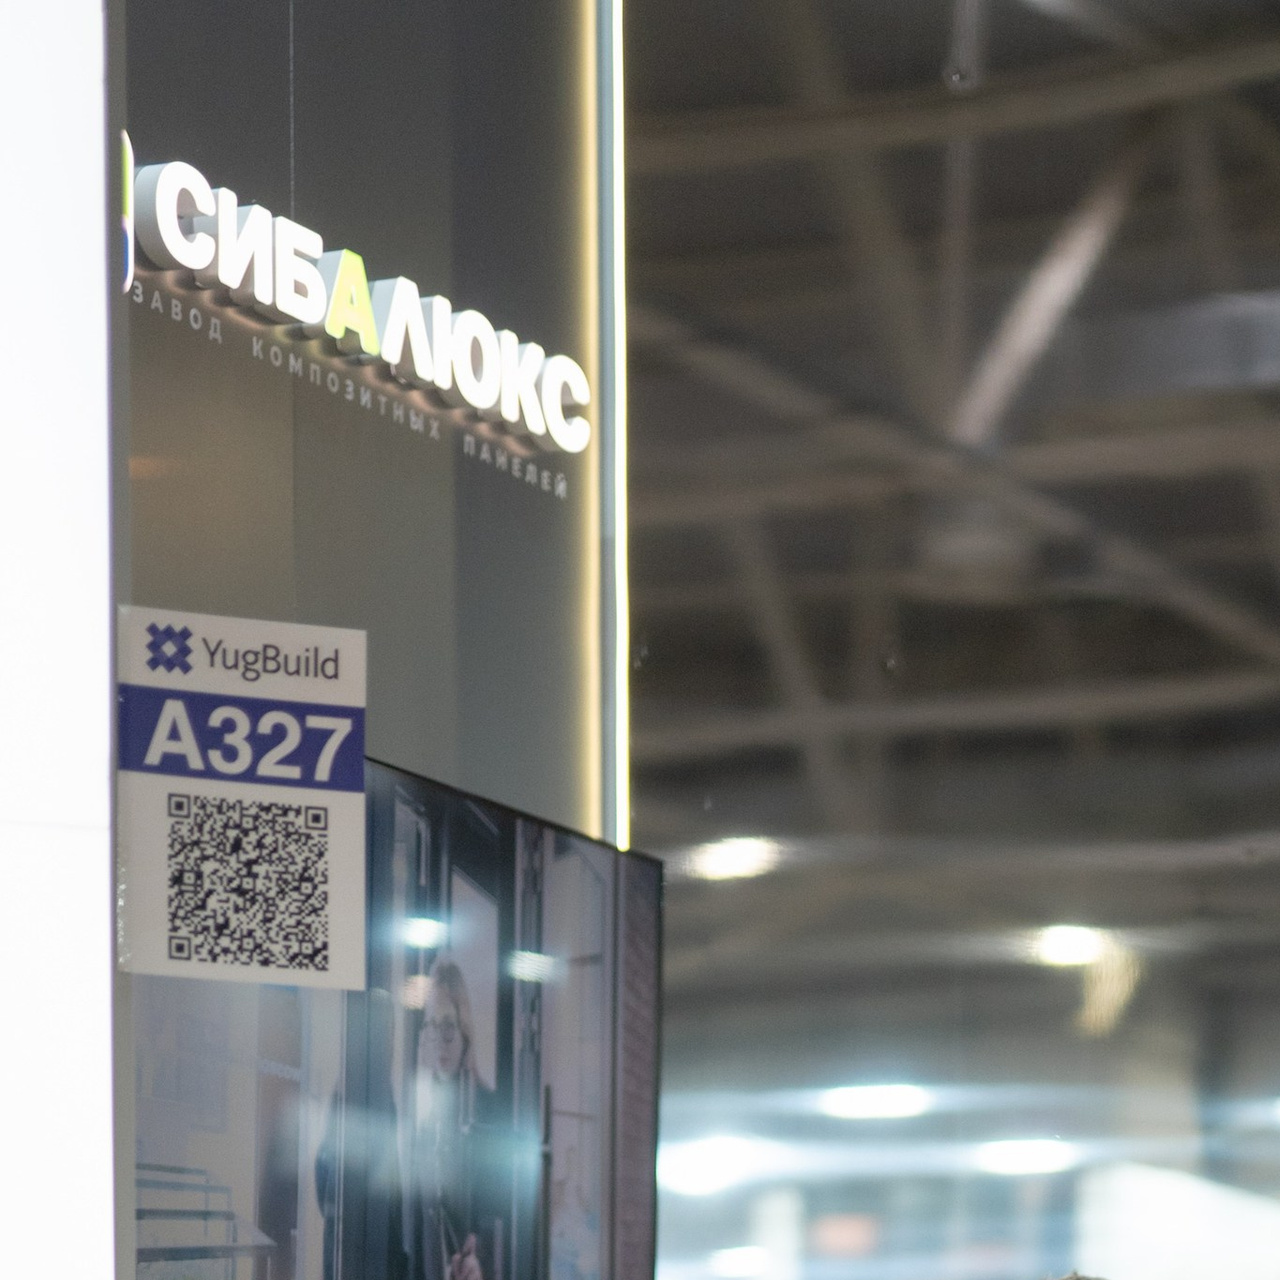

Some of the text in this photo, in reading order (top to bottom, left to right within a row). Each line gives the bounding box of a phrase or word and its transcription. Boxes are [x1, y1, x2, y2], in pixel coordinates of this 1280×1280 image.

[150, 161, 592, 454] СИБАЛЮКС
[132, 281, 568, 500] ЗАВОД КОМПОЗИТНЫХ ПАНЕЛЕЙ
[201, 637, 340, 682] YugBuild
[143, 698, 353, 782] A327
